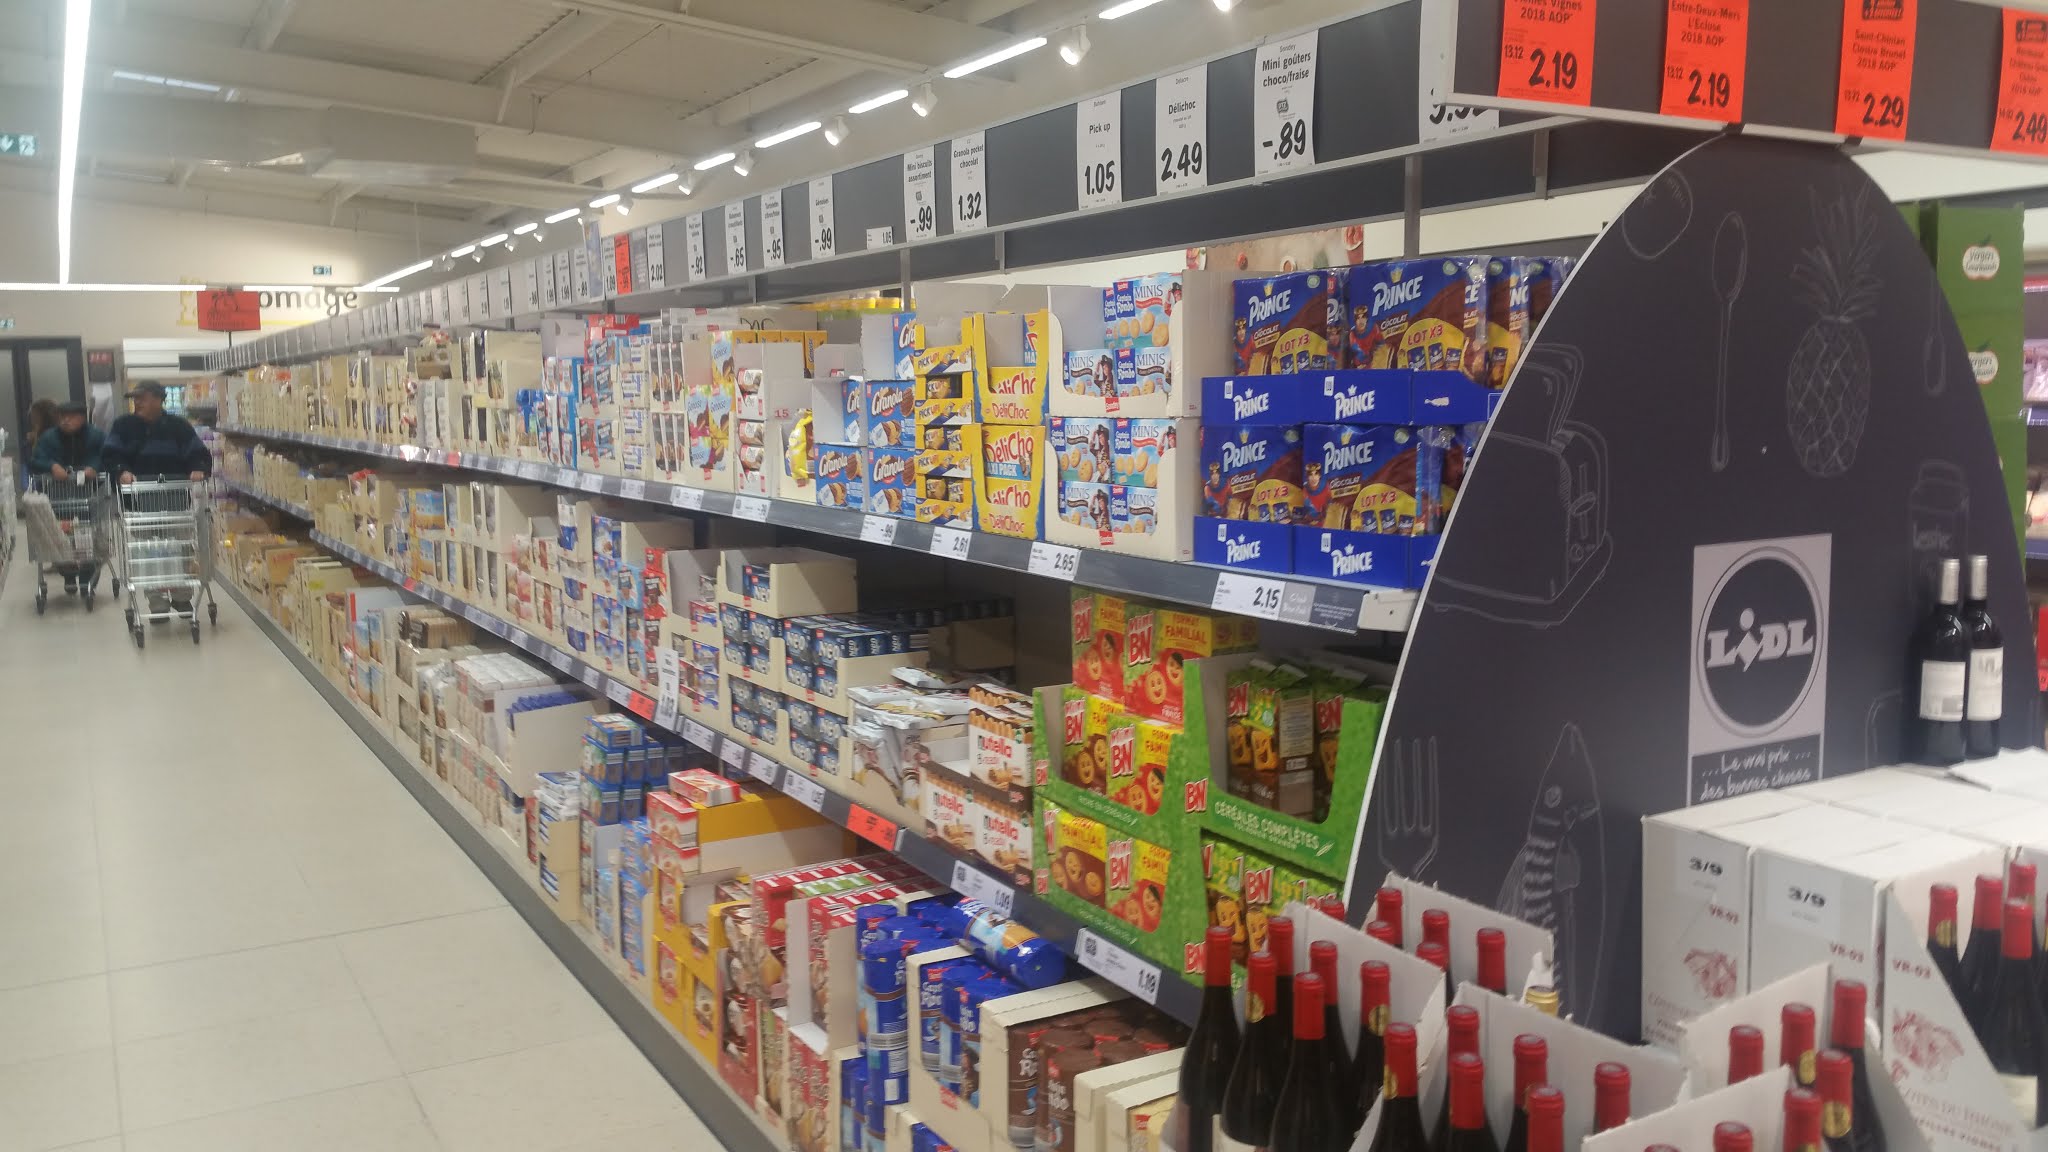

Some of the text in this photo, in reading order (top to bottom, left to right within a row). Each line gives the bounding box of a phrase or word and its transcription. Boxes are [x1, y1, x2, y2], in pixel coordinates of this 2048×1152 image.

[1520, 7, 1545, 22] 2018
[1681, 31, 1703, 44] 2018
[1262, 51, 1311, 71] Mini goûters
[1528, 48, 1578, 90] 2.19
[1262, 67, 1309, 87] choco/fraise
[1687, 69, 1731, 108] 2.19
[1168, 100, 1196, 115] Délichoc
[1862, 92, 1905, 128] 2.29
[1089, 122, 1111, 134] Pick up
[1262, 119, 1306, 160] -.89
[2013, 110, 2048, 144] 2.49
[953, 147, 970, 158] Granola
[960, 157, 979, 169] chocolat
[1161, 141, 1203, 182] 2.49
[1084, 160, 1115, 195] 1.05
[958, 191, 982, 221] 1.32
[910, 205, 932, 233] -.99
[814, 228, 832, 251] -.99
[1134, 284, 1163, 298] MINIS
[1372, 275, 1423, 317] PRINCE
[1248, 289, 1292, 328] PRINCE
[1280, 338, 1295, 353] LOT
[1407, 330, 1427, 346] LOT
[1070, 356, 1094, 368] MINIS
[1136, 353, 1165, 366] MINIS
[871, 386, 903, 415] Granola
[992, 402, 1030, 420] DéliChoc
[1233, 392, 1270, 421] PRINCE
[1334, 389, 1375, 421] PRINCE
[775, 409, 789, 418] 15
[1066, 424, 1090, 436] MINIS
[1132, 425, 1160, 438] MINIS
[984, 431, 1034, 463] DéliCho
[1222, 439, 1267, 473] PRINCE
[1323, 440, 1374, 474] PRINCE
[819, 450, 848, 478] Granola
[873, 455, 905, 482] Granola
[987, 463, 1018, 477] AXI PACK
[1066, 486, 1090, 499] MINIS
[1128, 494, 1155, 507] MINIS
[1361, 494, 1377, 508] LOT
[953, 536, 969, 553] 2.61
[1226, 539, 1261, 564] PRINCE
[1054, 553, 1075, 571] 2.65
[1331, 549, 1373, 577] PRINCE
[1253, 586, 1281, 610] 2.15
[1074, 608, 1092, 644] BN
[1165, 625, 1207, 645] FAMILIAL
[1128, 626, 1153, 666] BN
[1227, 682, 1249, 717] BN
[1317, 694, 1343, 734] BN
[1065, 712, 1084, 745] BN
[977, 735, 1012, 759] nutella
[1111, 739, 1134, 778] BN
[1185, 778, 1208, 813] BN
[1700, 768, 1812, 801] des bonnes choses
[933, 792, 965, 816] nutella
[983, 815, 1019, 841] nutella
[1110, 854, 1130, 890] BN
[1689, 857, 1723, 876] 3/9
[1245, 866, 1274, 904] BN
[1788, 886, 1826, 908] 3/9
[1893, 959, 1932, 979] VR-03
